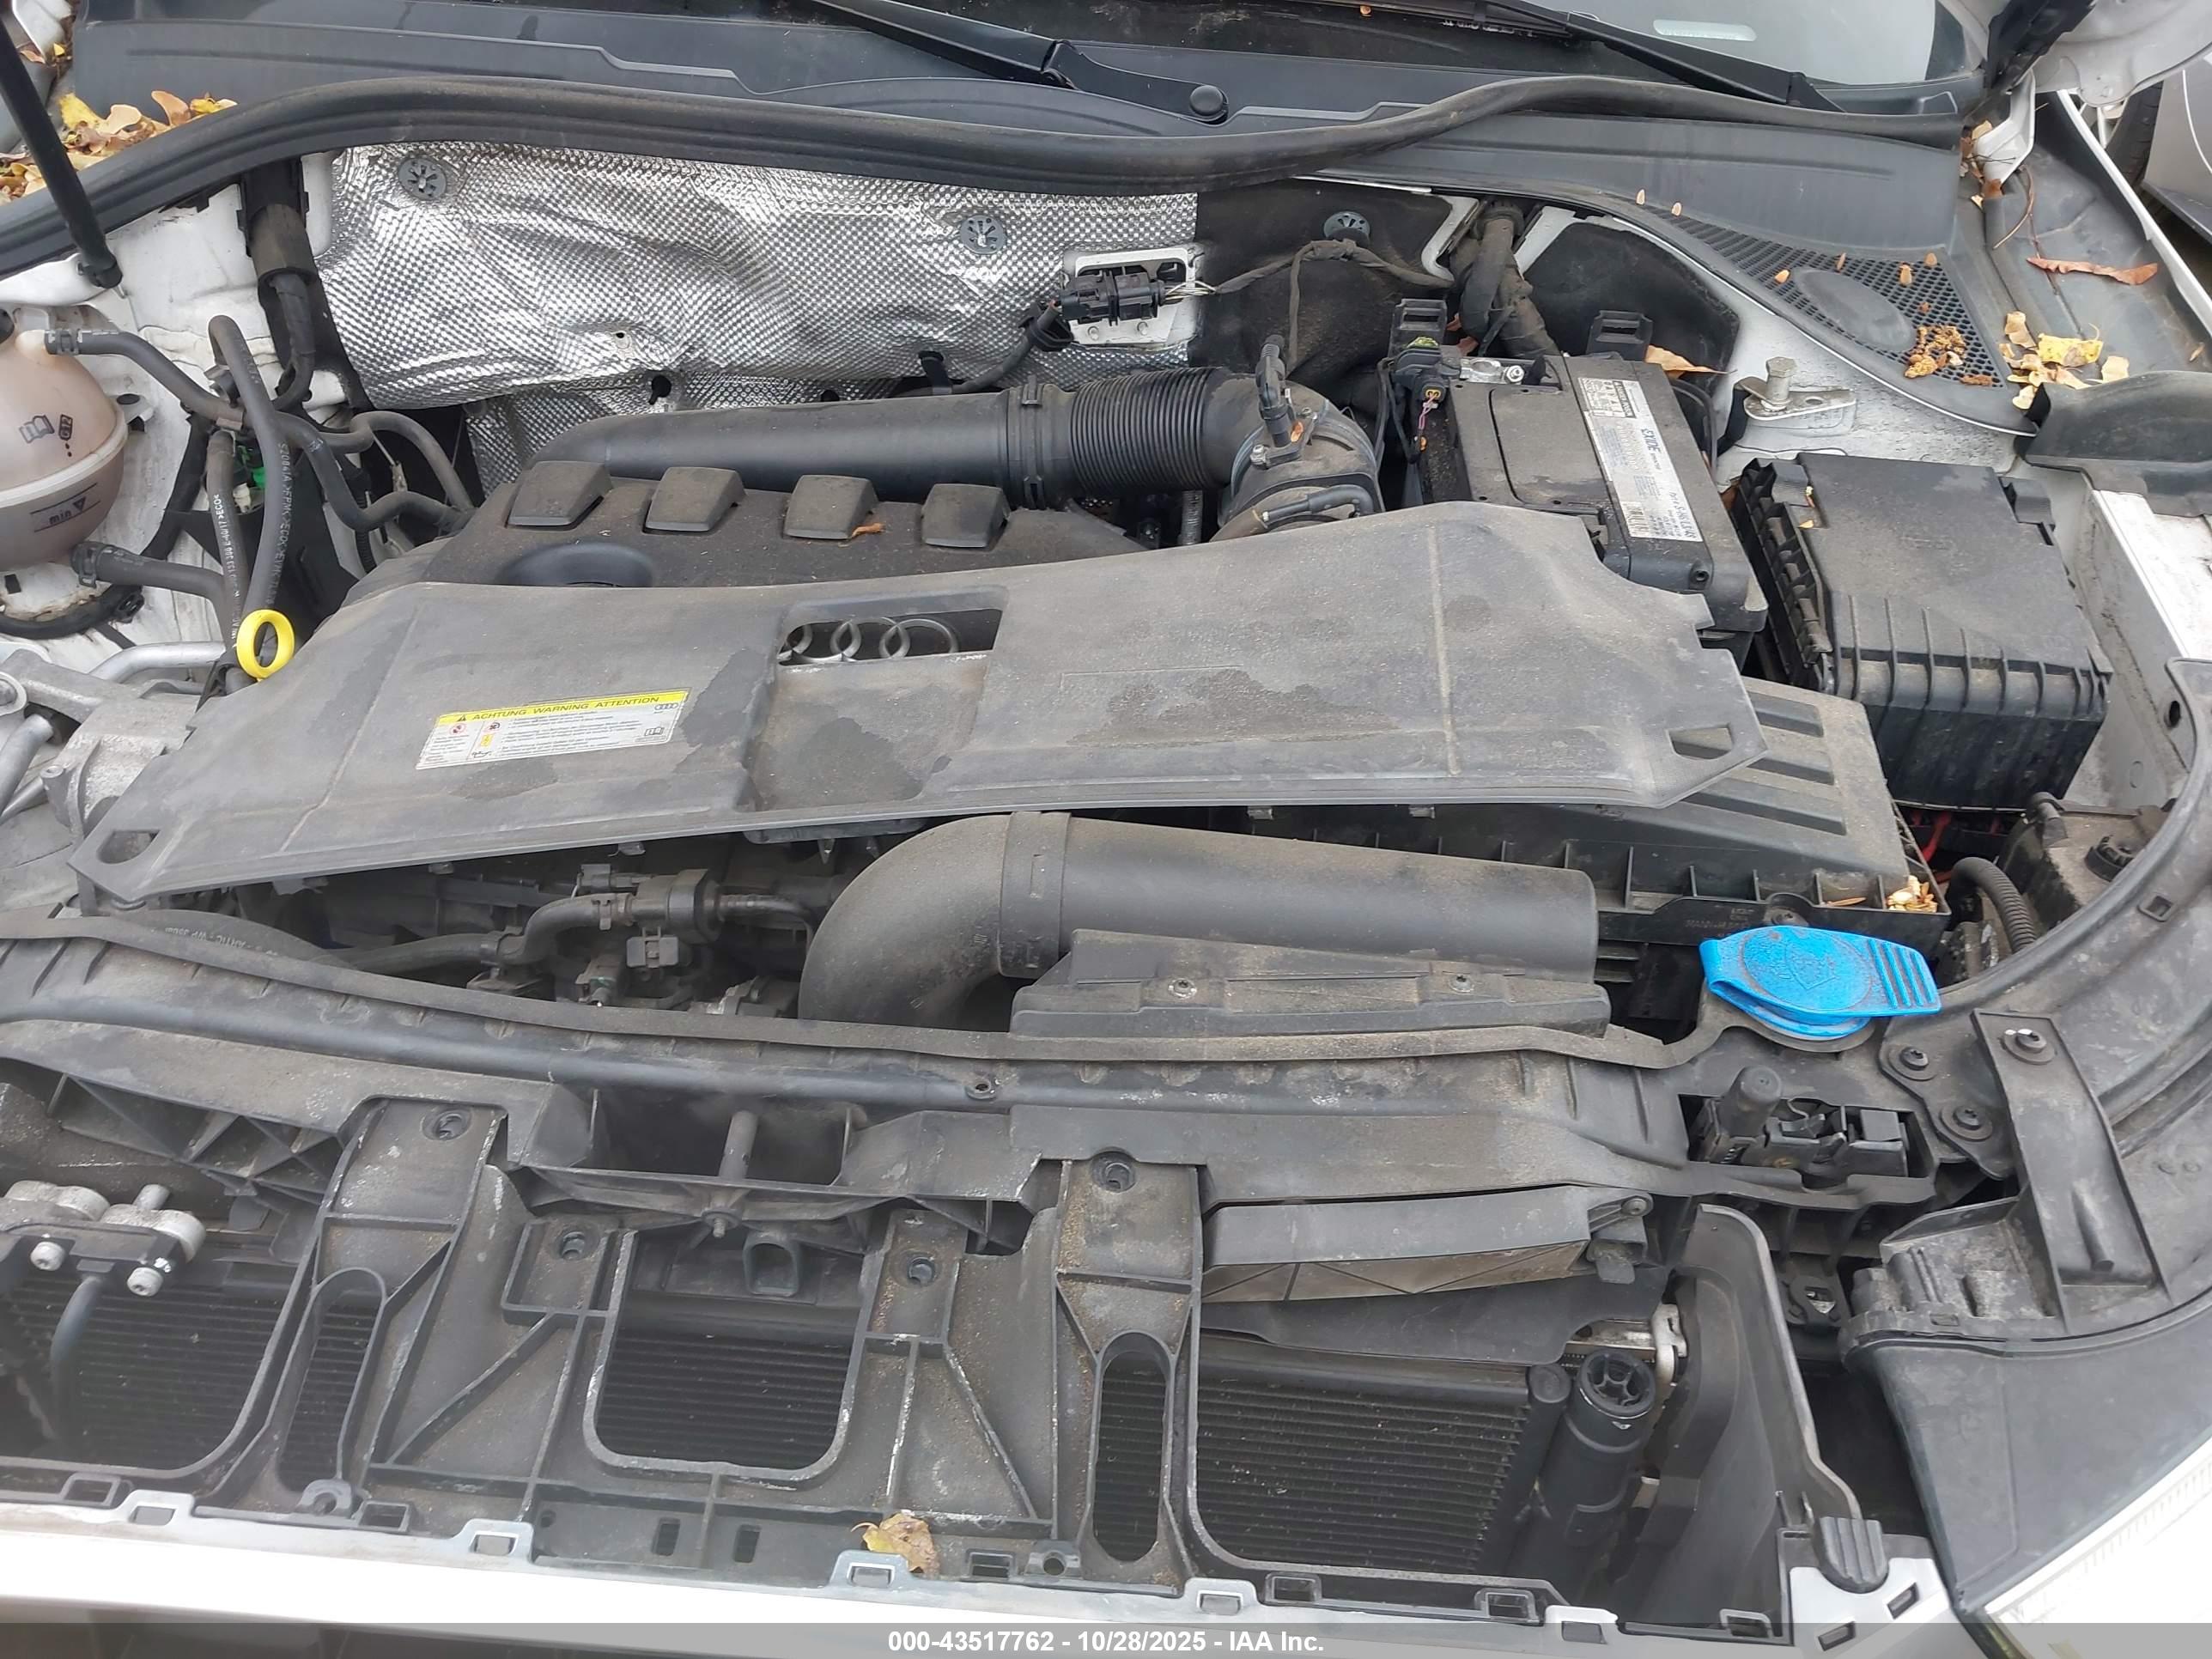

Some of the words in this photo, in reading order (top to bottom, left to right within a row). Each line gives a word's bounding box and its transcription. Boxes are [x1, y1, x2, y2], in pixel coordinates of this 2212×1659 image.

[1640, 428, 1662, 454] EXIDE
[48, 509, 73, 526] min
[471, 708, 528, 721] ACHTUNG
[532, 702, 590, 714] WARNING
[593, 695, 660, 708] ATTENTION
